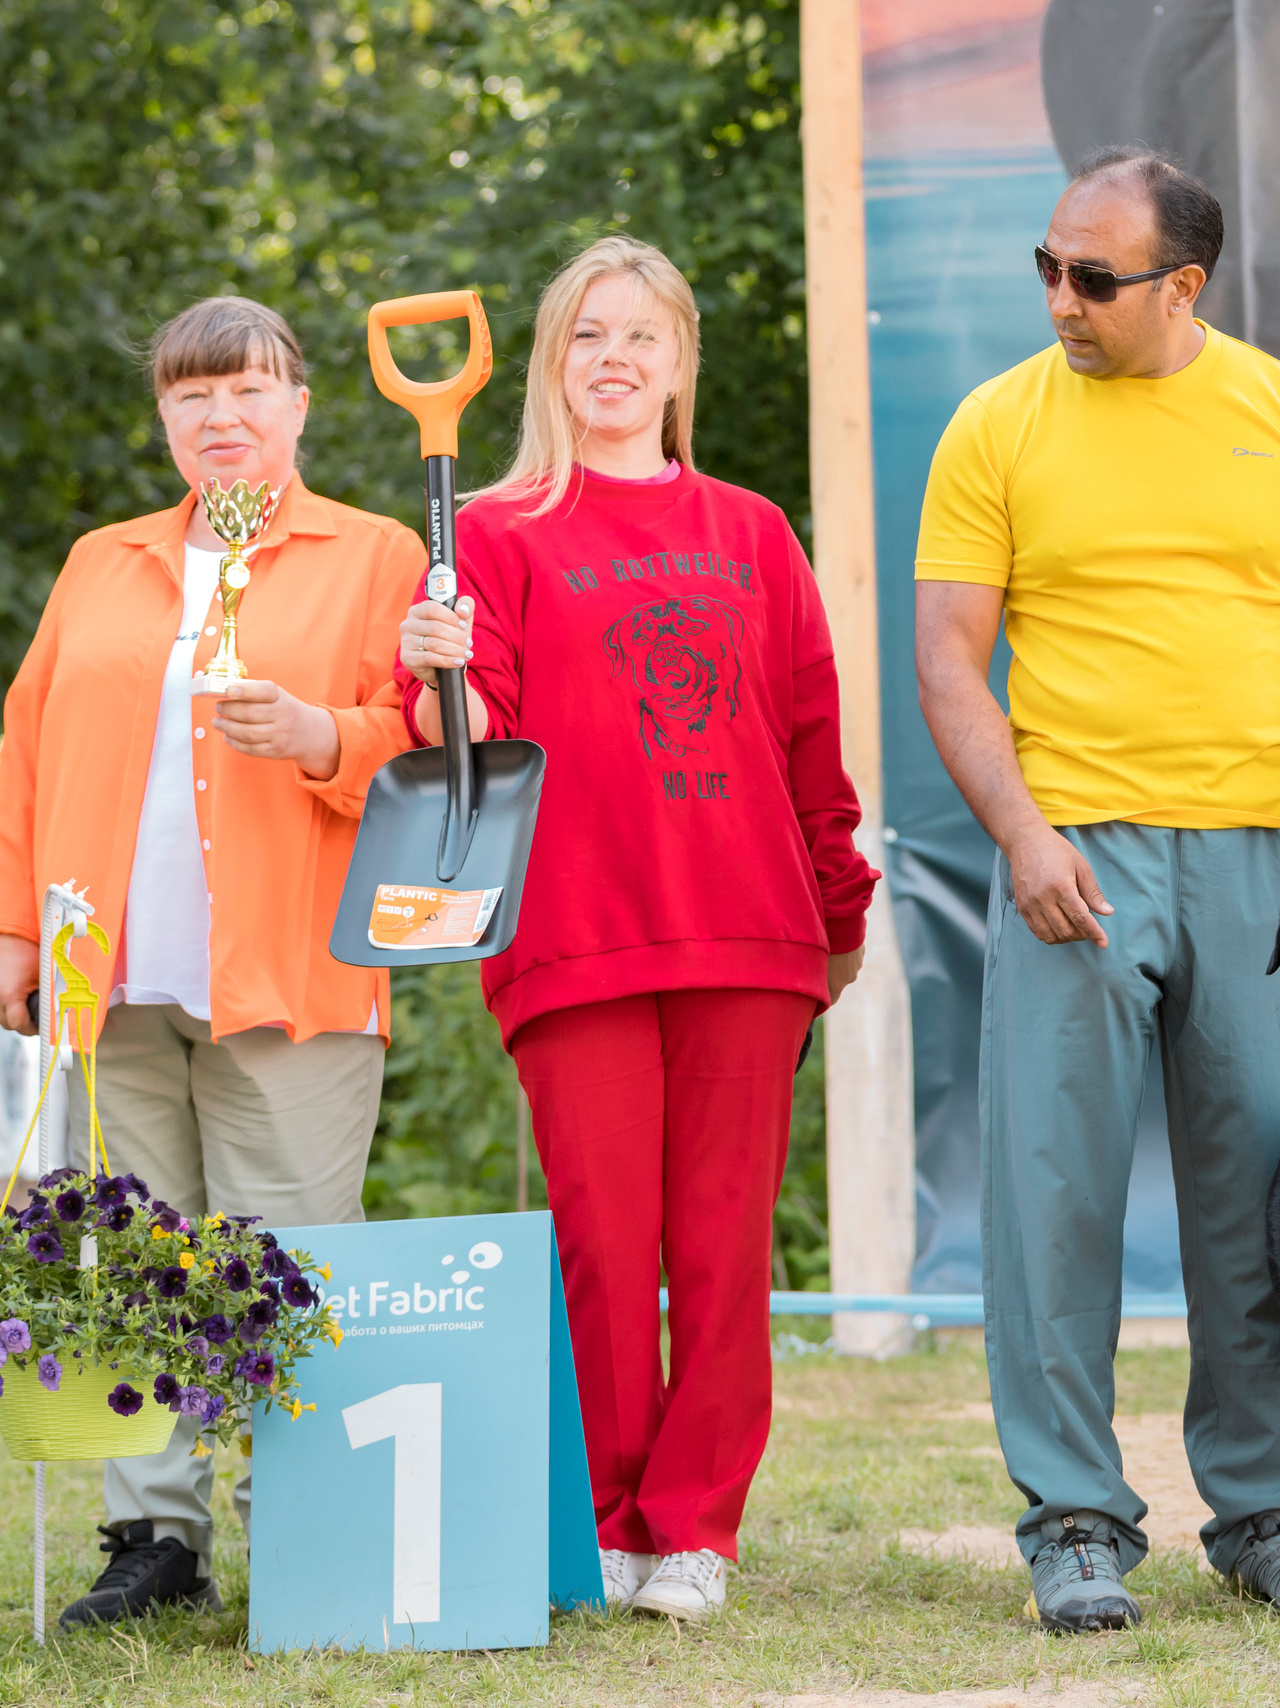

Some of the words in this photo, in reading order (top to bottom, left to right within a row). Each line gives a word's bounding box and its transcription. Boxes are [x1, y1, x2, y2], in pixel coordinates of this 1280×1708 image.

[431, 498, 442, 560] PLANTIC
[436, 577, 446, 590] 3
[563, 566, 599, 594] NO
[663, 771, 687, 800] NO
[696, 771, 730, 800] LIFE
[380, 887, 438, 902] PLANTIC
[369, 1271, 485, 1318] Fabric
[342, 1325, 377, 1338] абота
[379, 1326, 387, 1335] о
[389, 1322, 426, 1335] ваших
[428, 1319, 485, 1333] питомцах
[341, 1382, 442, 1624] 1
